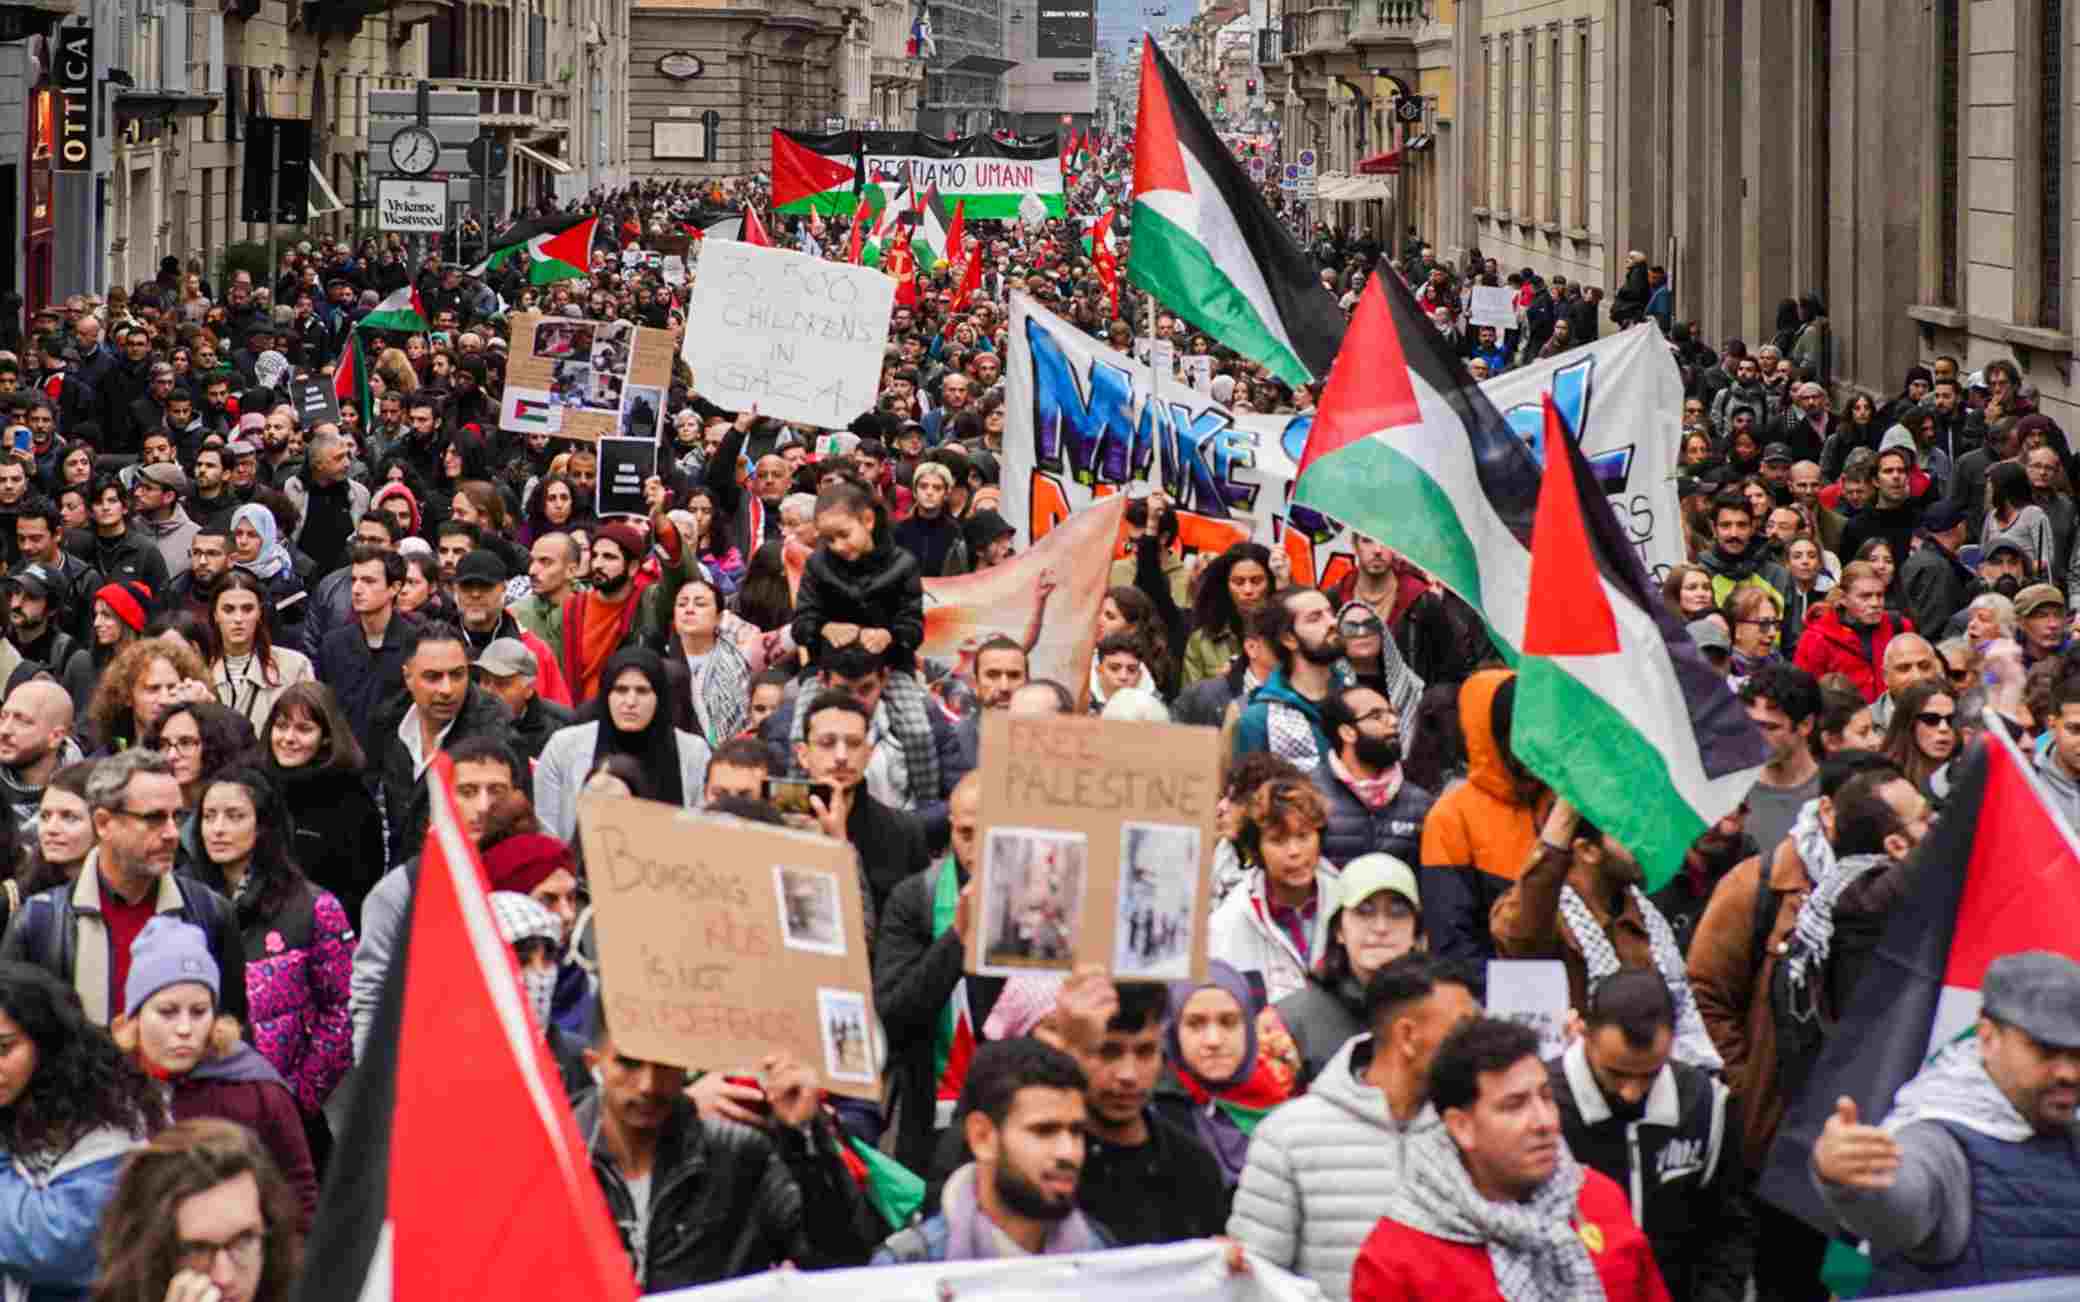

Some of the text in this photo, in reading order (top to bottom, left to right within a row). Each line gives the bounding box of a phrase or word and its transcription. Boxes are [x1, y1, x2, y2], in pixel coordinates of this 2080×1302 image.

[63, 38, 88, 162] OTTICA
[868, 158, 1033, 189] RETIAMO UMANI
[383, 210, 444, 226] Westwood
[384, 199, 437, 213] Vivienne
[769, 343, 796, 364] IN
[712, 362, 852, 417] GAZA
[1025, 315, 1260, 520] MAKE
[1008, 718, 1104, 761] FREE
